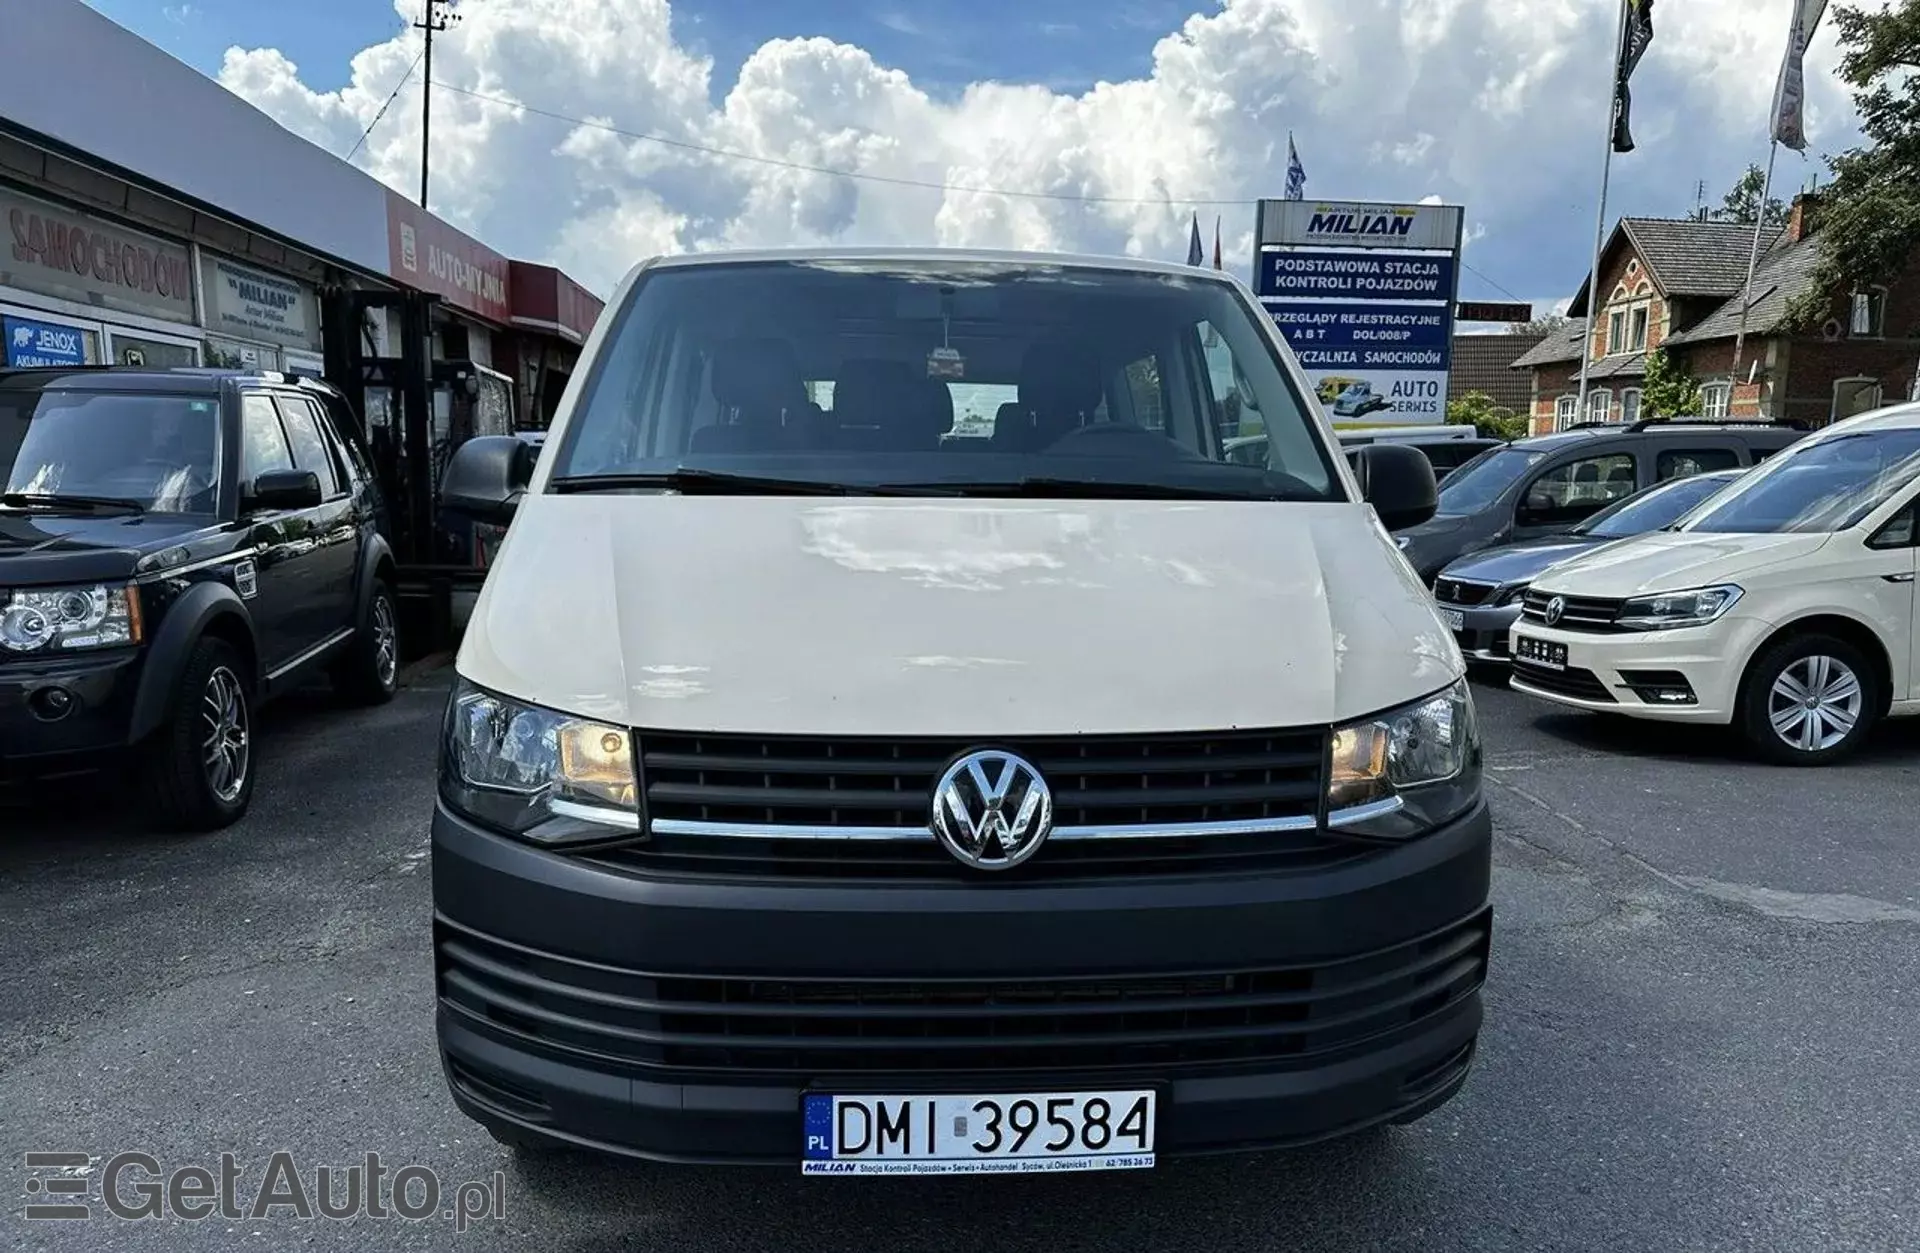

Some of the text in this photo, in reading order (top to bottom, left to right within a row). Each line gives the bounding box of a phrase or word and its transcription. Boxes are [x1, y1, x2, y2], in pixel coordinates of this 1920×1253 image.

[1308, 214, 1414, 235] MILIAN
[1275, 259, 1440, 275] PODSTAWOWA STACJA
[1275, 275, 1438, 291] KONTROLI POJAZDÓW
[1340, 313, 1440, 325] REJESTRACYJNE
[36, 330, 77, 351] JENOX
[1293, 329, 1303, 339] A
[1306, 329, 1314, 339] B
[1317, 329, 1326, 339] T
[1295, 349, 1441, 364] YCZALNIA SAMOCHODÓW
[1391, 380, 1439, 397] AUTO
[1390, 400, 1437, 413] SERWIS
[838, 1096, 1149, 1154] DMI 39584
[808, 1136, 829, 1150] PL
[804, 1163, 856, 1172] MILIAN
[860, 1164, 882, 1174] Stacja
[884, 1163, 911, 1172] Kontroli
[953, 1163, 975, 1172] Serwis
[980, 1162, 1018, 1171] Autohandel
